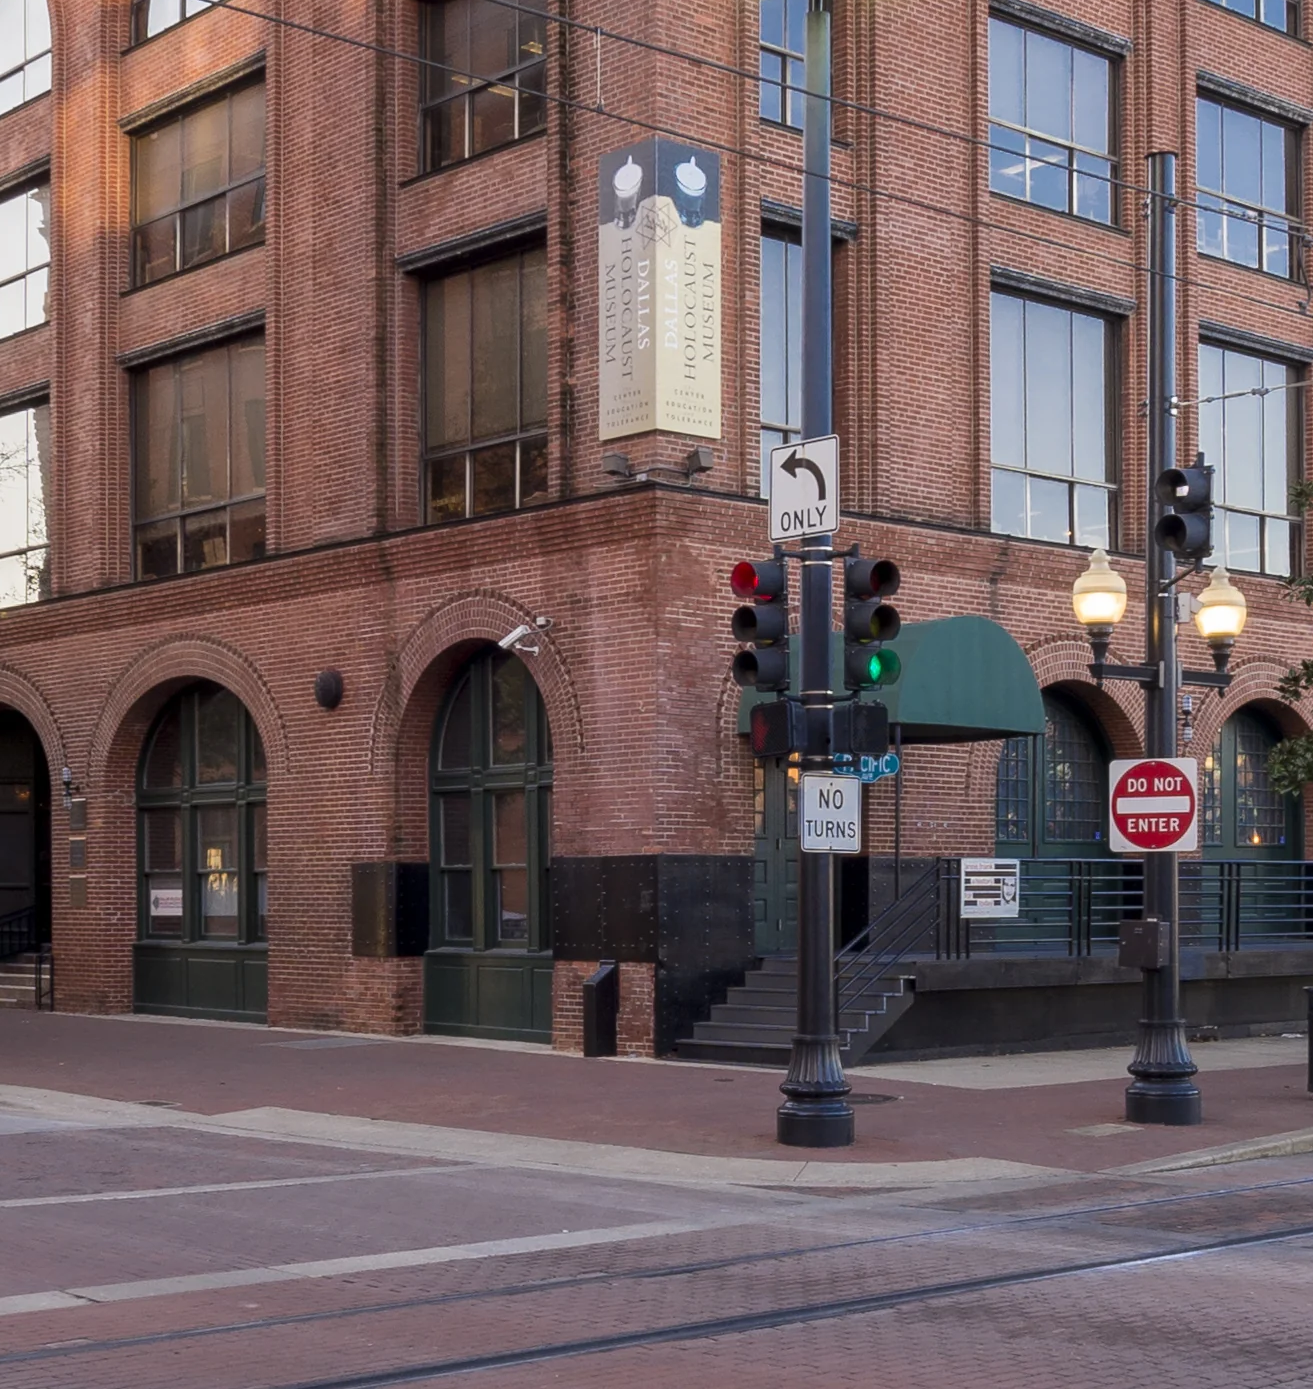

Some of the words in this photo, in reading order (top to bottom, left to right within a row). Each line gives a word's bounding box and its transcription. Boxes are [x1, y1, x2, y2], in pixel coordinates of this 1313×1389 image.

[605, 264, 616, 363] MUSEUM
[621, 237, 633, 381] HOLOCAUST
[638, 259, 650, 350] DALLAS
[665, 259, 678, 350] DALLAS
[684, 235, 697, 381] HOLOCAUST
[702, 262, 714, 363] MUSEUM
[614, 390, 641, 401] CENTER
[674, 389, 705, 400] CENTER
[607, 401, 649, 416] EDUCATION
[666, 401, 713, 414] EDUCATION
[606, 414, 649, 427] TOLERANCE
[666, 413, 713, 427] TOLERANCE
[780, 505, 827, 532] ONLY
[843, 754, 891, 773] PCIFIC
[1128, 778, 1147, 792] DO
[1154, 777, 1183, 791] NOT
[819, 789, 843, 809] NO
[805, 820, 856, 839] TURNS
[1127, 818, 1180, 832] ENTER
